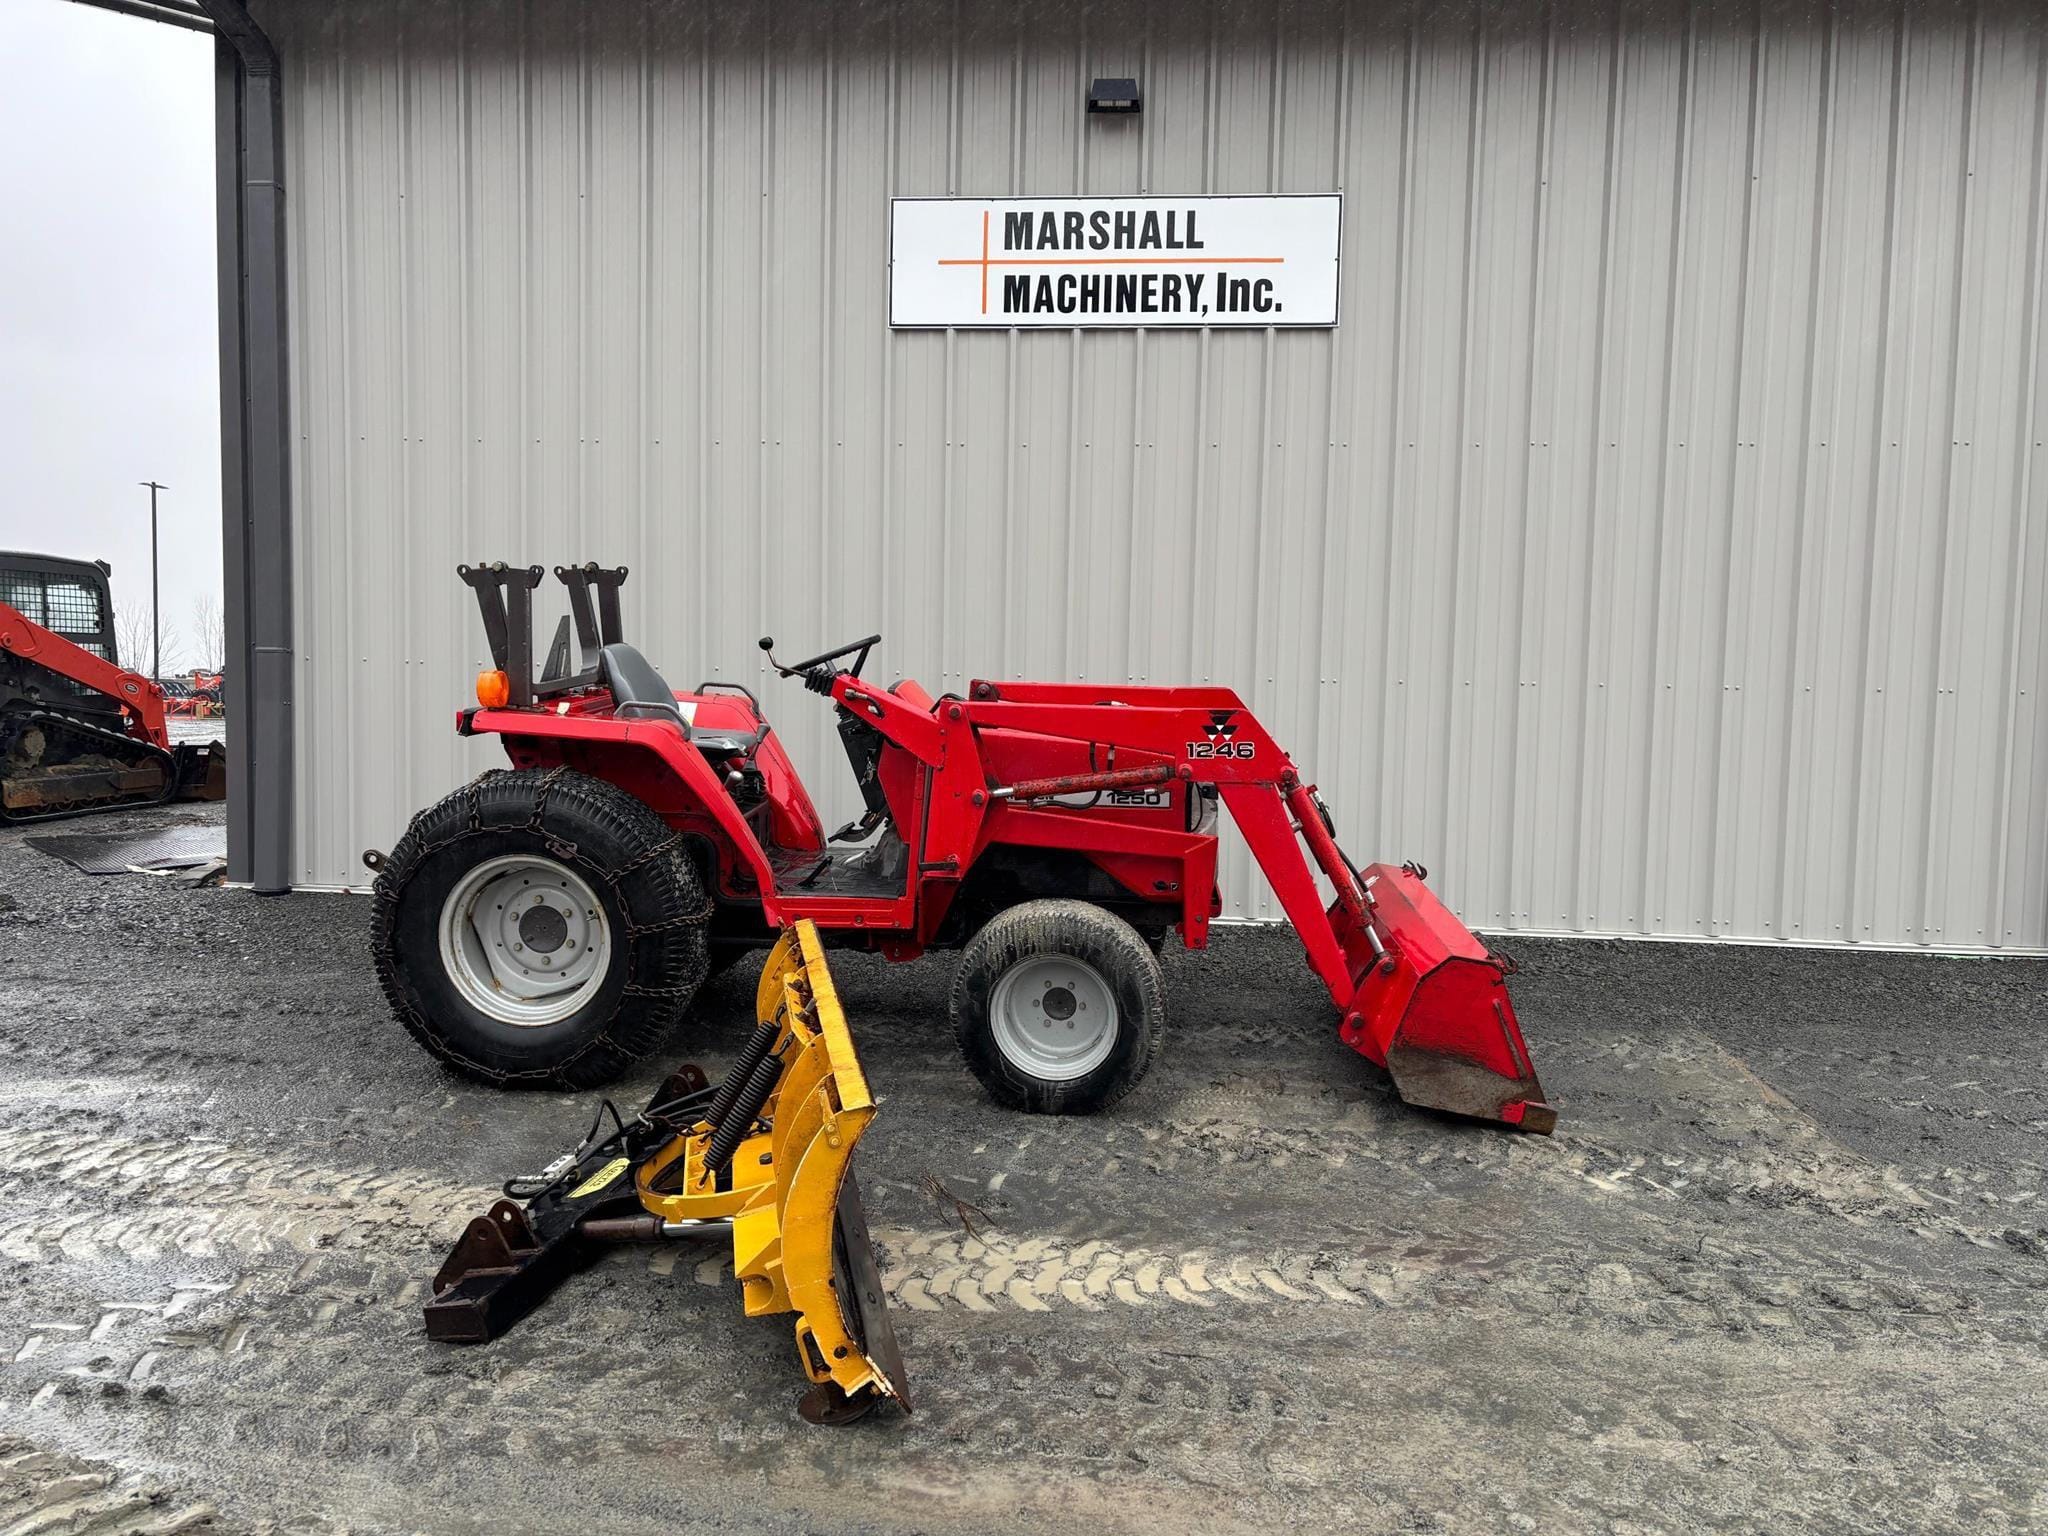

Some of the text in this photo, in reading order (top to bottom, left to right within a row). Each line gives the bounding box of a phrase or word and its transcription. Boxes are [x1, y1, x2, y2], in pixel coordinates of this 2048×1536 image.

[1004, 210, 1204, 250] MARSHALL
[1004, 272, 1282, 317] MACHINERY, Inc.
[1186, 741, 1255, 759] 1246
[1107, 789, 1160, 805] 1250
